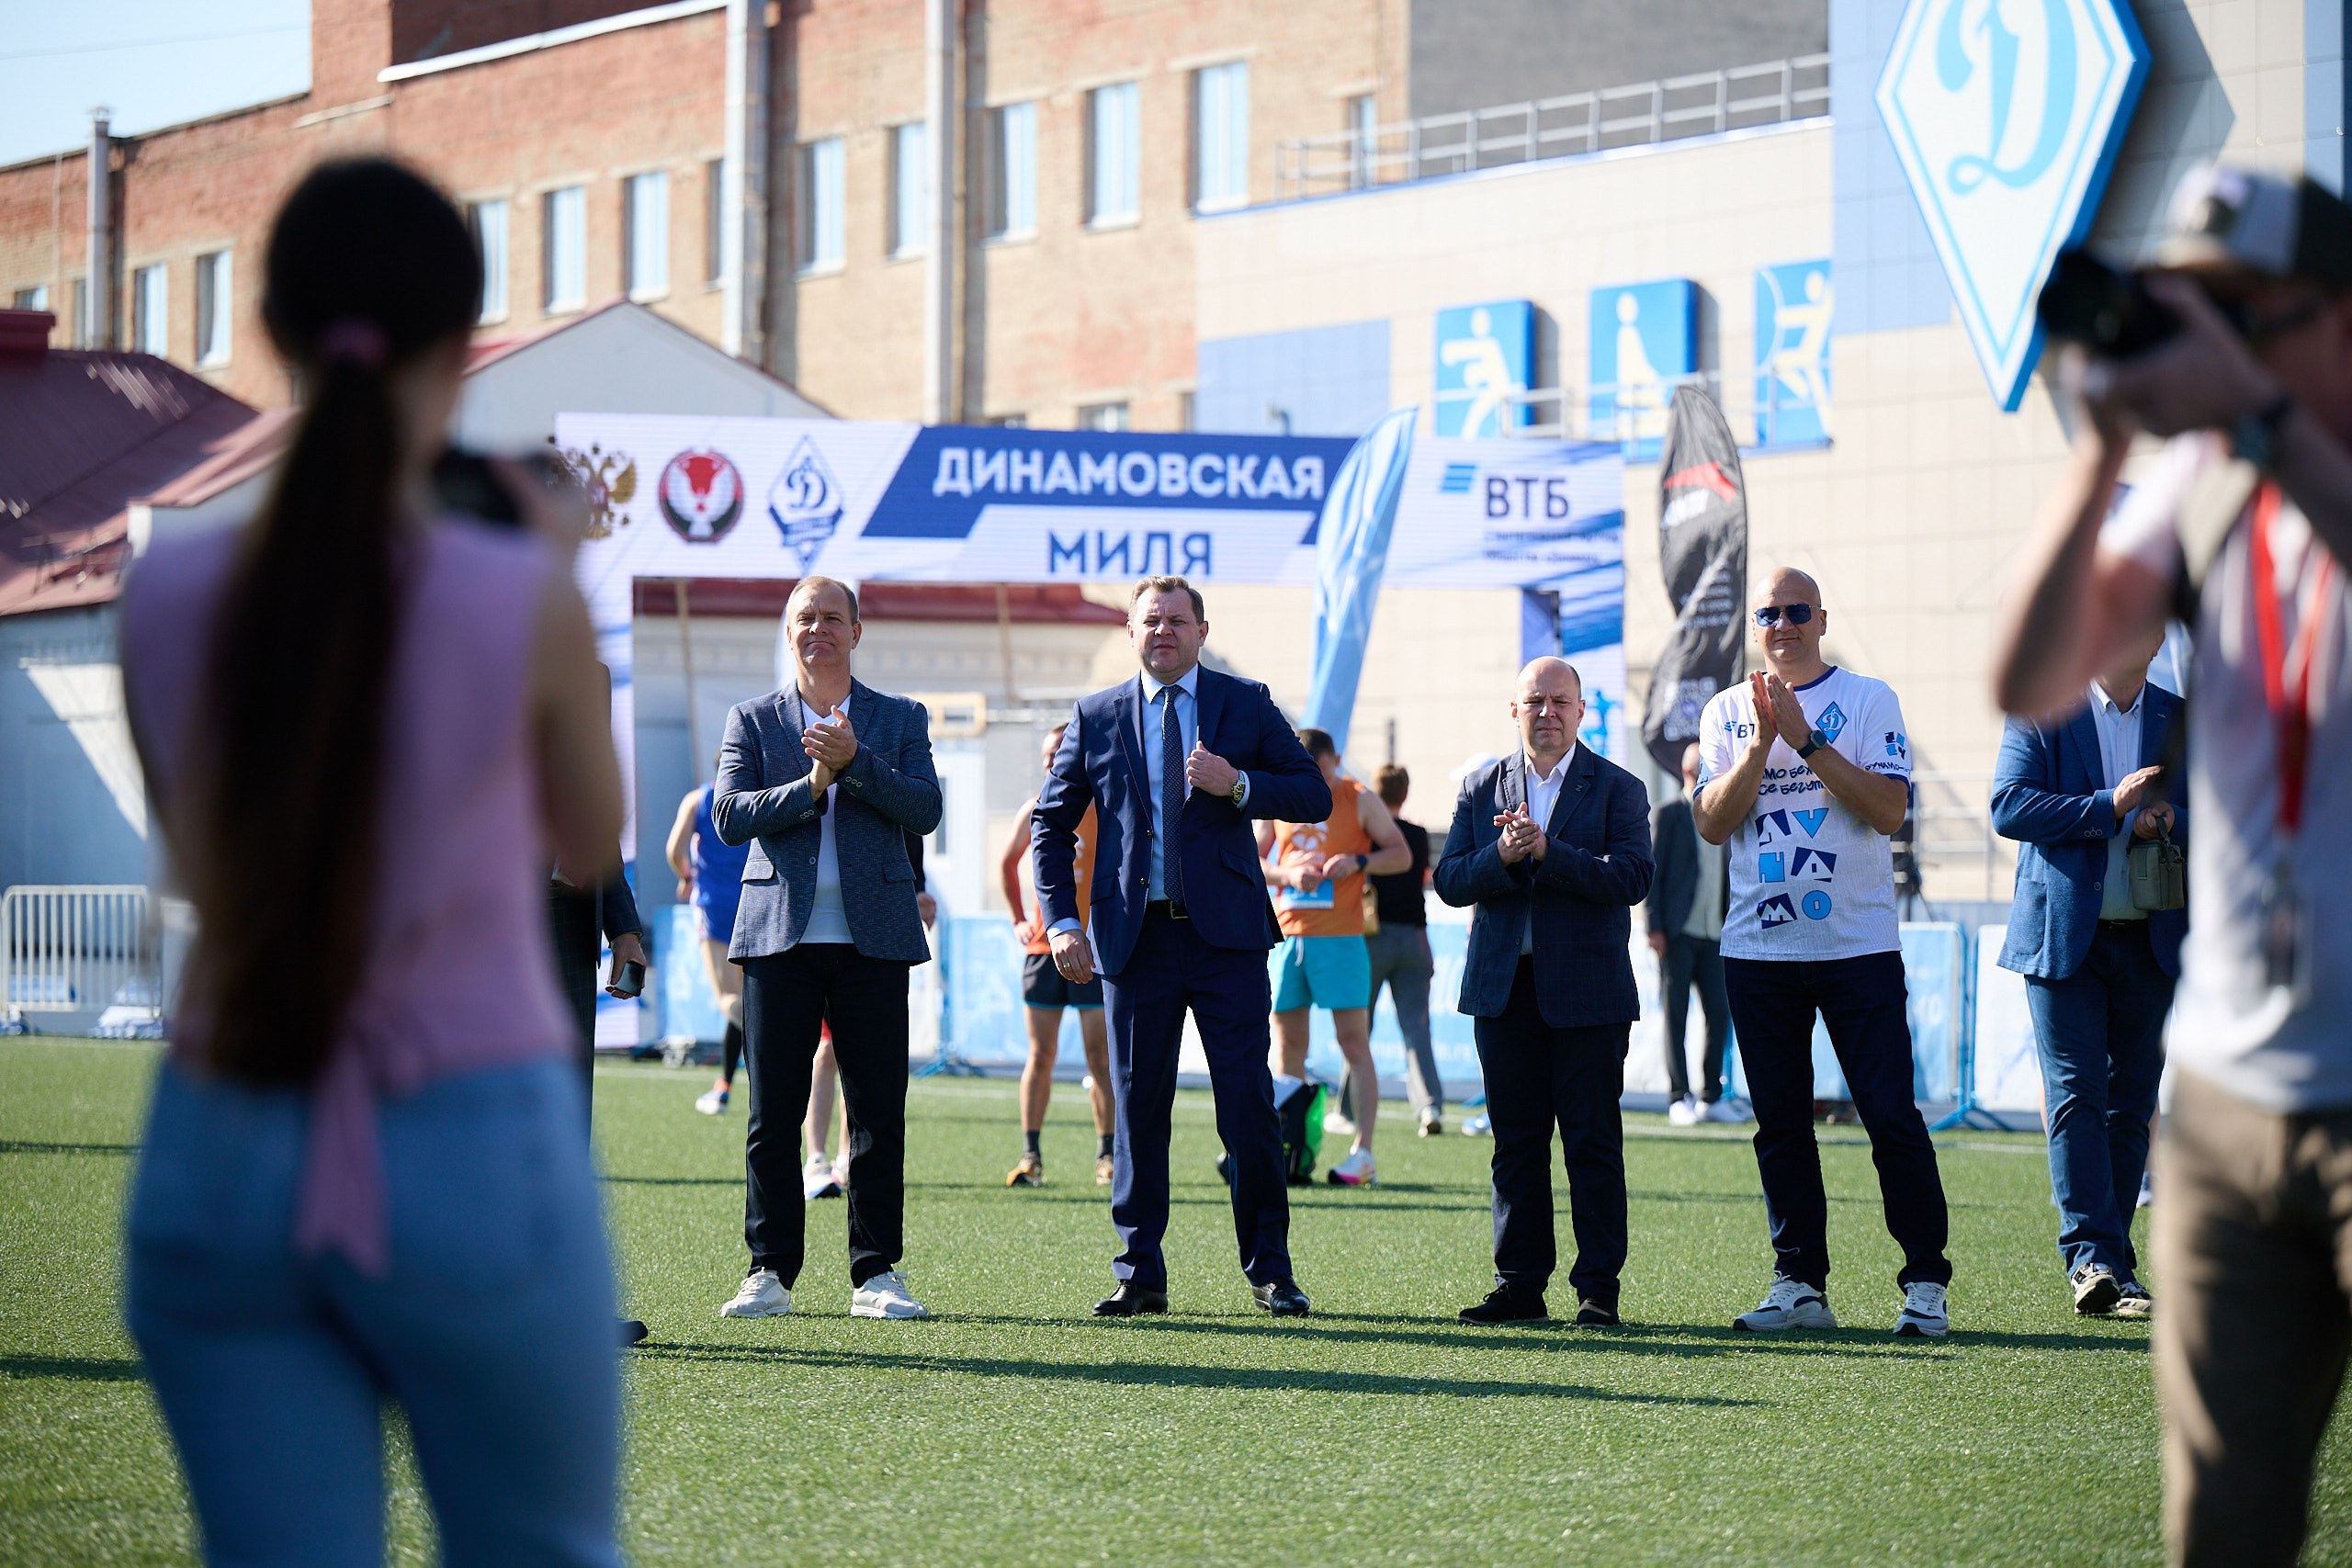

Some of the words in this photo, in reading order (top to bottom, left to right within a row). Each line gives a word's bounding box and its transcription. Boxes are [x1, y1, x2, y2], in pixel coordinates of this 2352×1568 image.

[933, 446, 1325, 500] ДИНАМОВСКАЯ
[1487, 478, 1569, 519] ВТБ
[1048, 530, 1212, 576] МИЛЯ
[1737, 723, 1755, 739] ВТ
